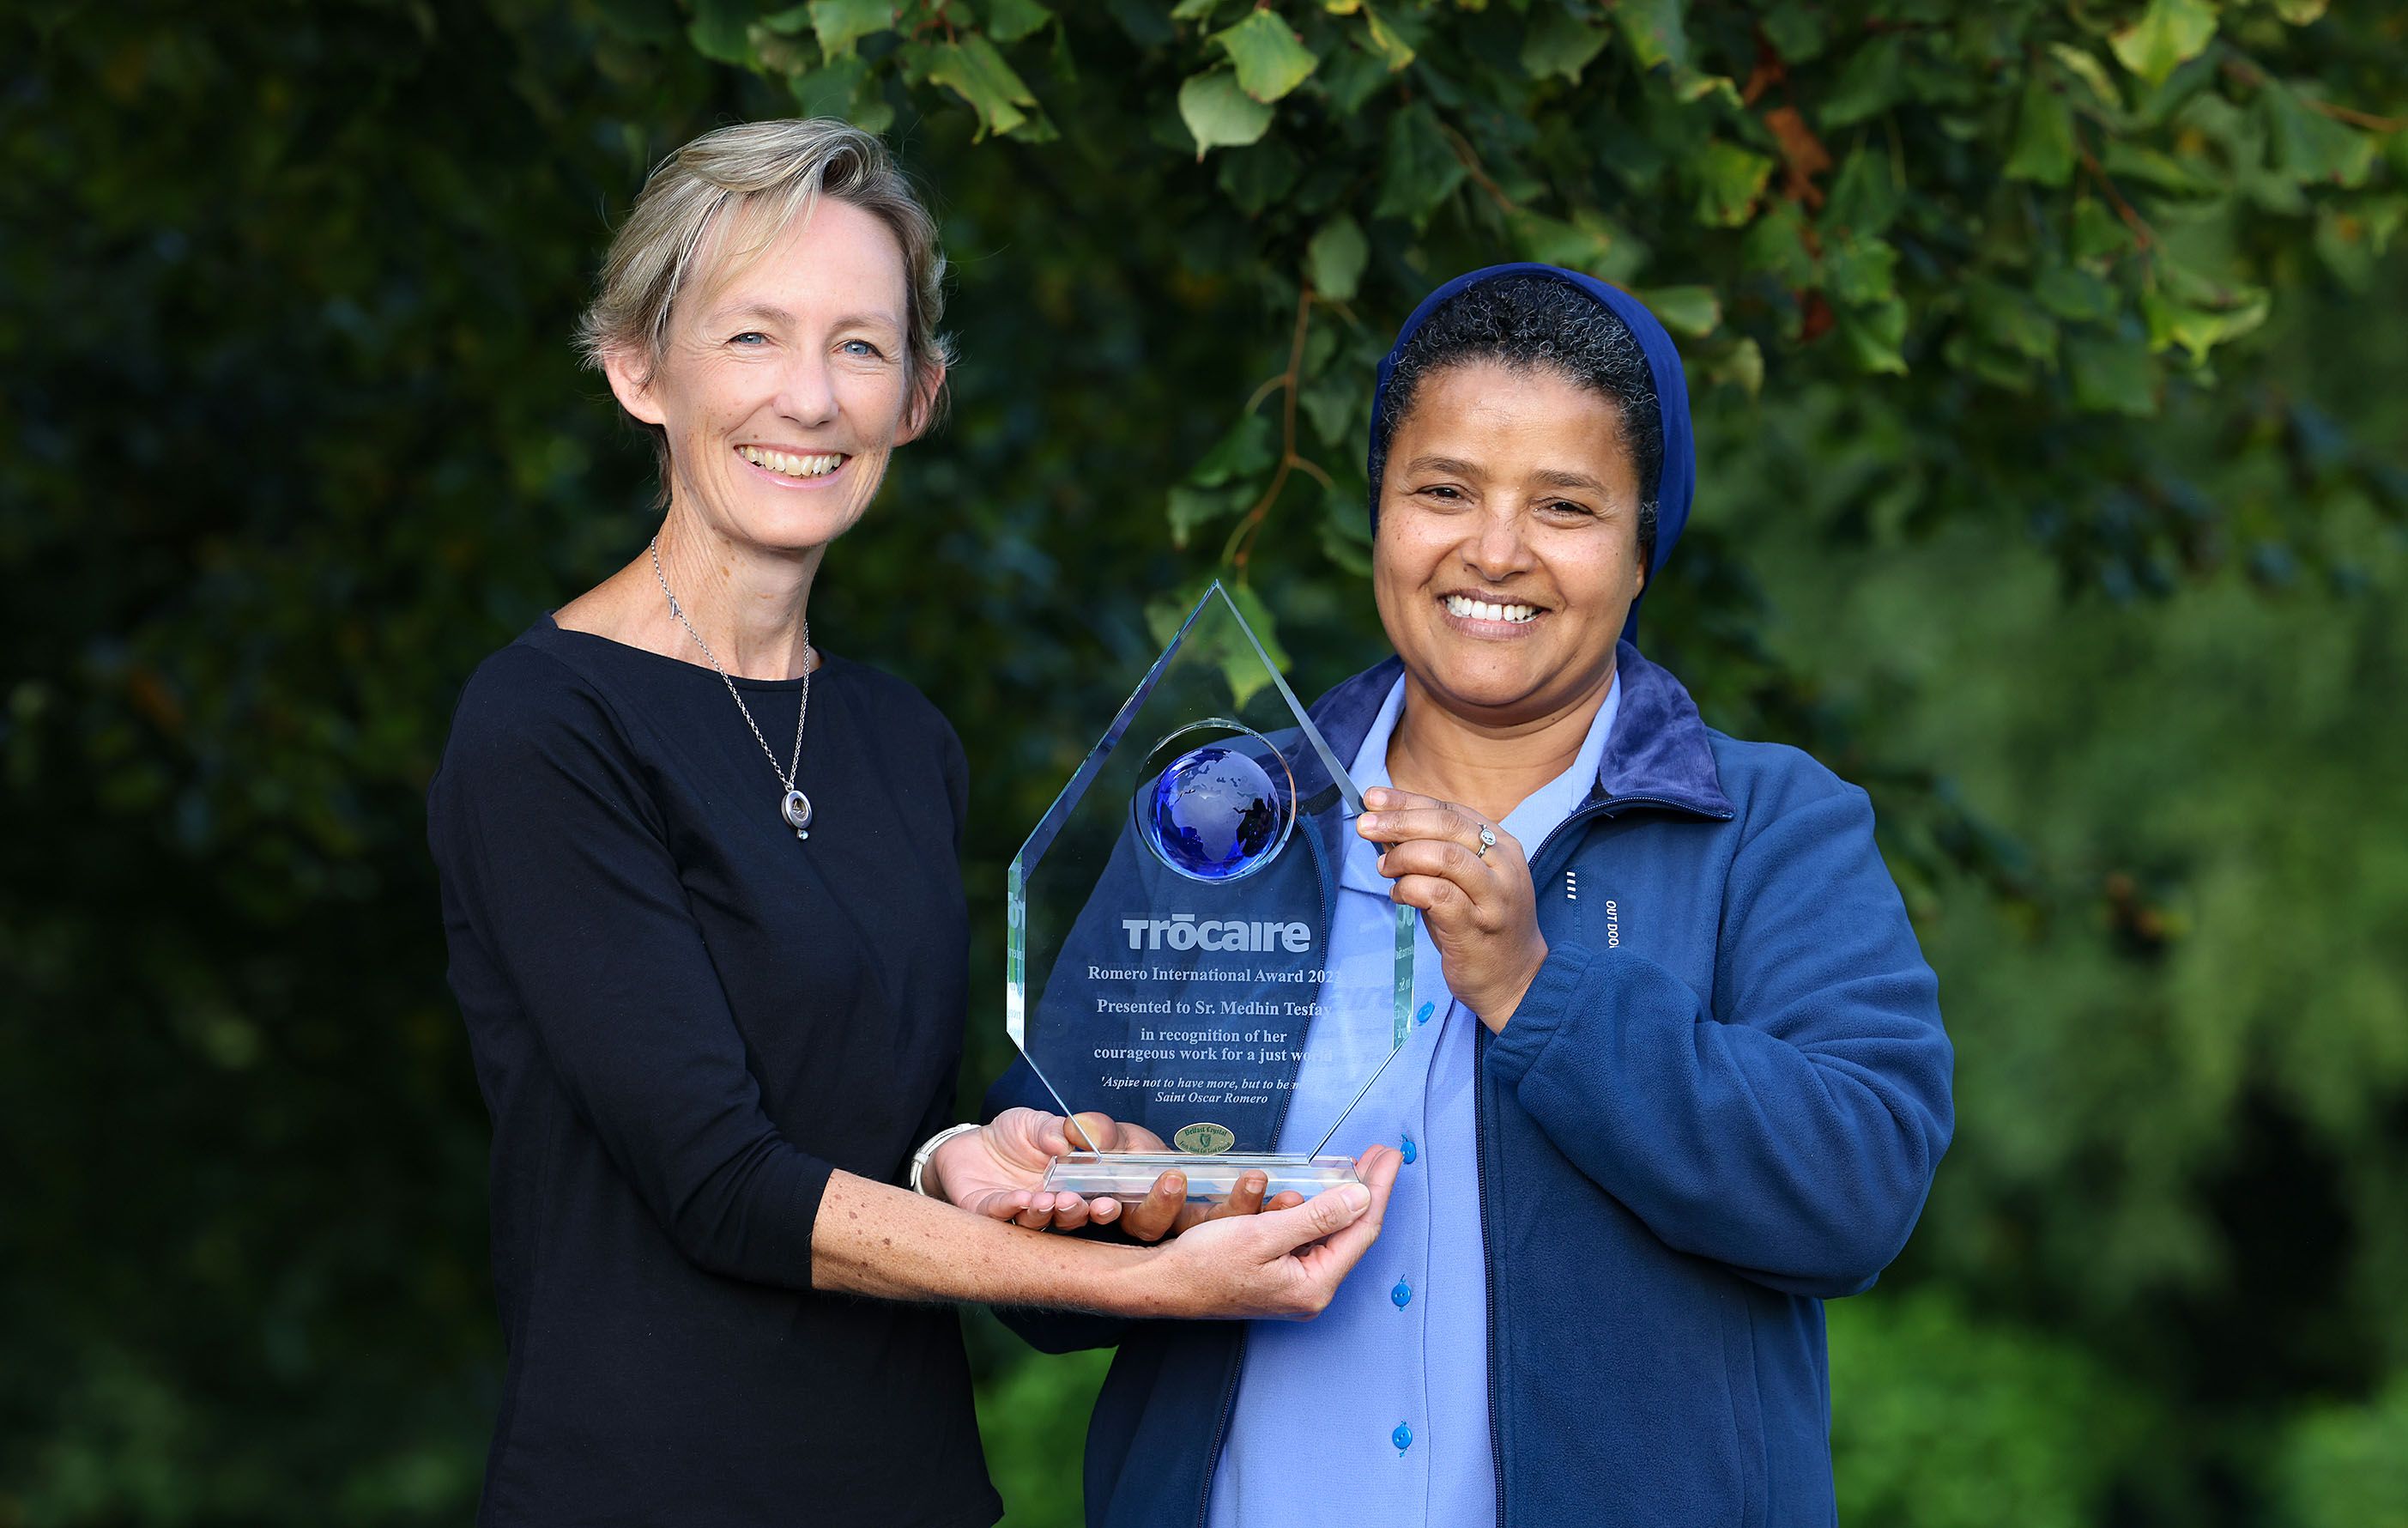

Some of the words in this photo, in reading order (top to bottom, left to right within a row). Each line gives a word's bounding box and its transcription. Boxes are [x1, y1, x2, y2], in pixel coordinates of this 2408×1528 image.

[1606, 900, 1618, 922] OUT
[1088, 966, 1148, 979] Romero
[1153, 967, 1251, 982] International
[1254, 969, 1304, 983] Award
[1097, 998, 1171, 1014] Presented
[1176, 1001, 1191, 1014] to
[1195, 1000, 1216, 1015] Sr.
[1220, 1001, 1280, 1016] Medhin
[1140, 1028, 1155, 1040] in
[1159, 1028, 1240, 1044] recognition
[1244, 1029, 1261, 1042] of
[1263, 1029, 1288, 1043] her
[1093, 1048, 1176, 1063] courageous
[1179, 1047, 1218, 1060] work
[1221, 1047, 1243, 1061] for
[1247, 1052, 1255, 1061] a
[1258, 1048, 1287, 1064] just
[1101, 1076, 1140, 1089] 'Aspire
[1142, 1078, 1161, 1088] not
[1163, 1078, 1175, 1088] to
[1177, 1077, 1204, 1088] have
[1206, 1080, 1238, 1090] more,
[1241, 1078, 1261, 1089] but
[1262, 1080, 1274, 1089] to
[1276, 1079, 1290, 1090] be
[1155, 1091, 1186, 1102] Saint
[1188, 1092, 1222, 1103] Oscar
[1224, 1093, 1268, 1104] Romero
[1185, 1127, 1205, 1136] Belfast
[1207, 1126, 1227, 1137] Crystal
